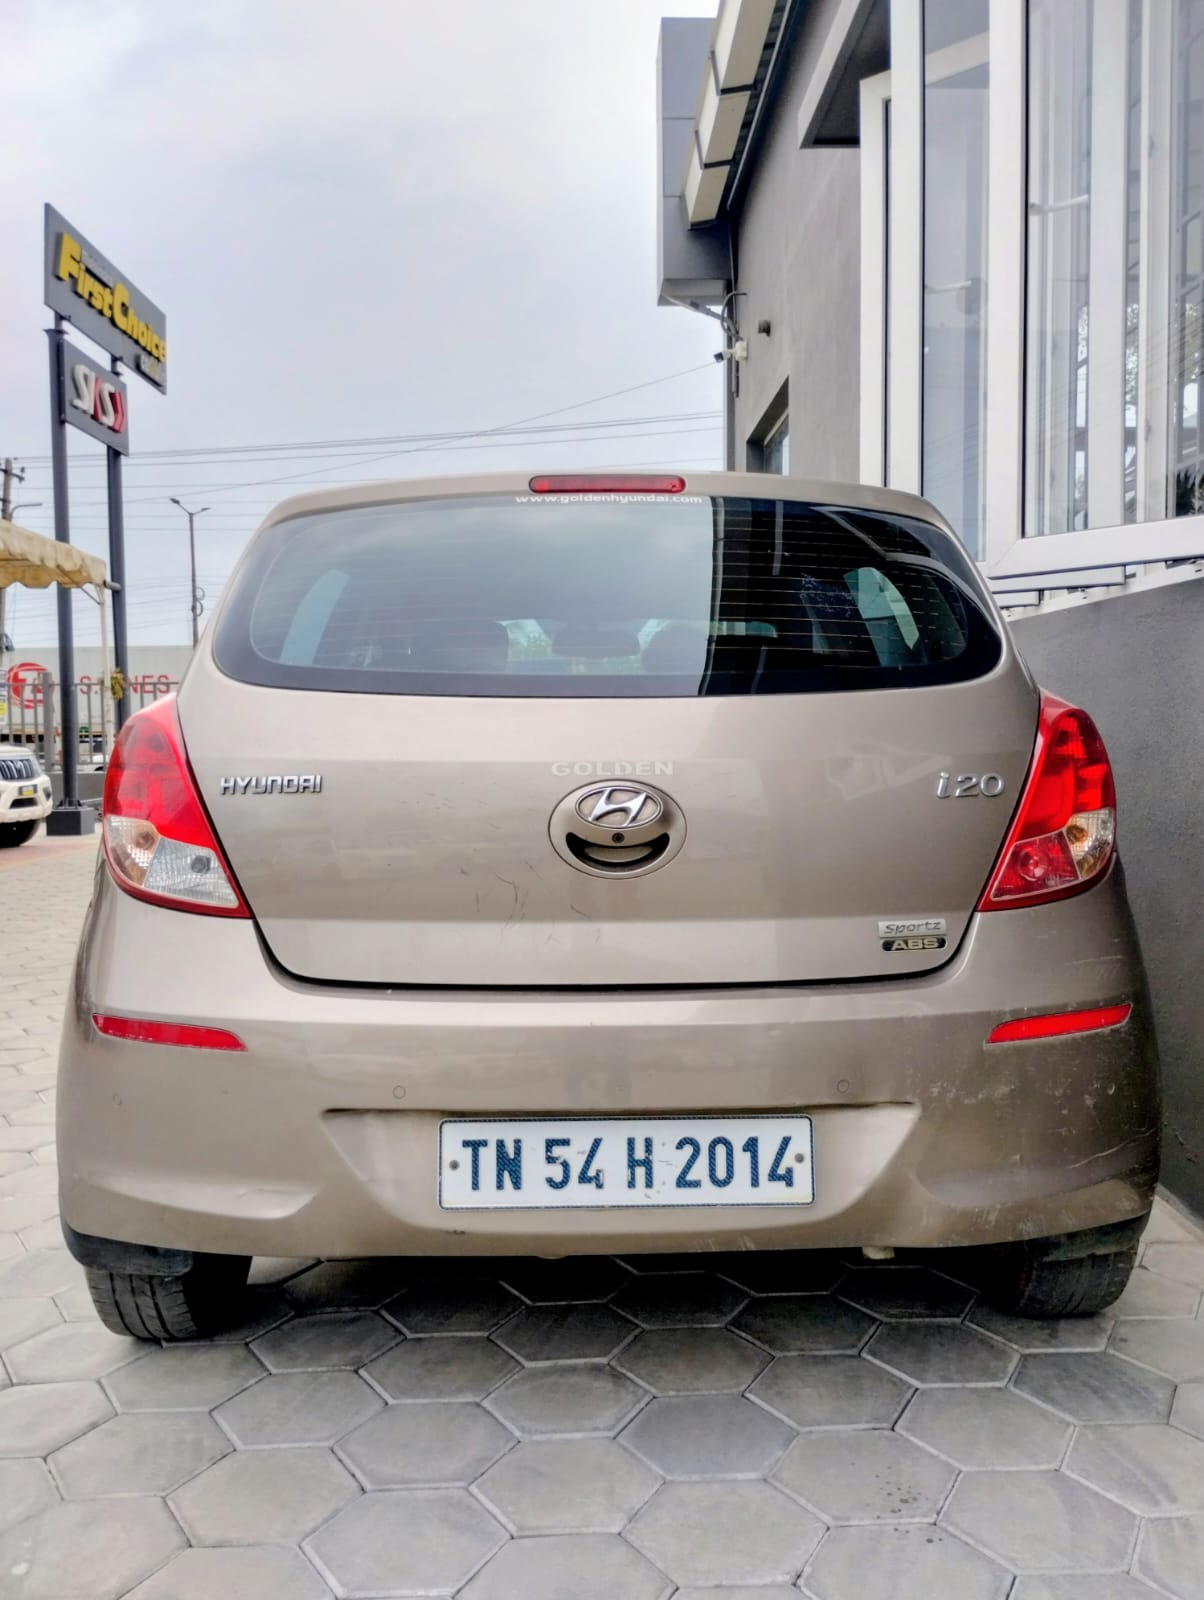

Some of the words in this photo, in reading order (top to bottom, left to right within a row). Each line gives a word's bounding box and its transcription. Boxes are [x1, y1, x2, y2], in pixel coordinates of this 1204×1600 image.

[515, 493, 703, 504] www.goldenhyundai.com
[551, 761, 674, 776] GOLDEN
[220, 774, 323, 796] HYUNDAI
[936, 771, 1005, 799] i20
[884, 920, 942, 935] Sportz
[890, 937, 939, 951] ABS
[462, 1137, 522, 1191] TN
[544, 1137, 604, 1190] 54
[626, 1136, 653, 1189] H
[675, 1135, 794, 1189] 2014
